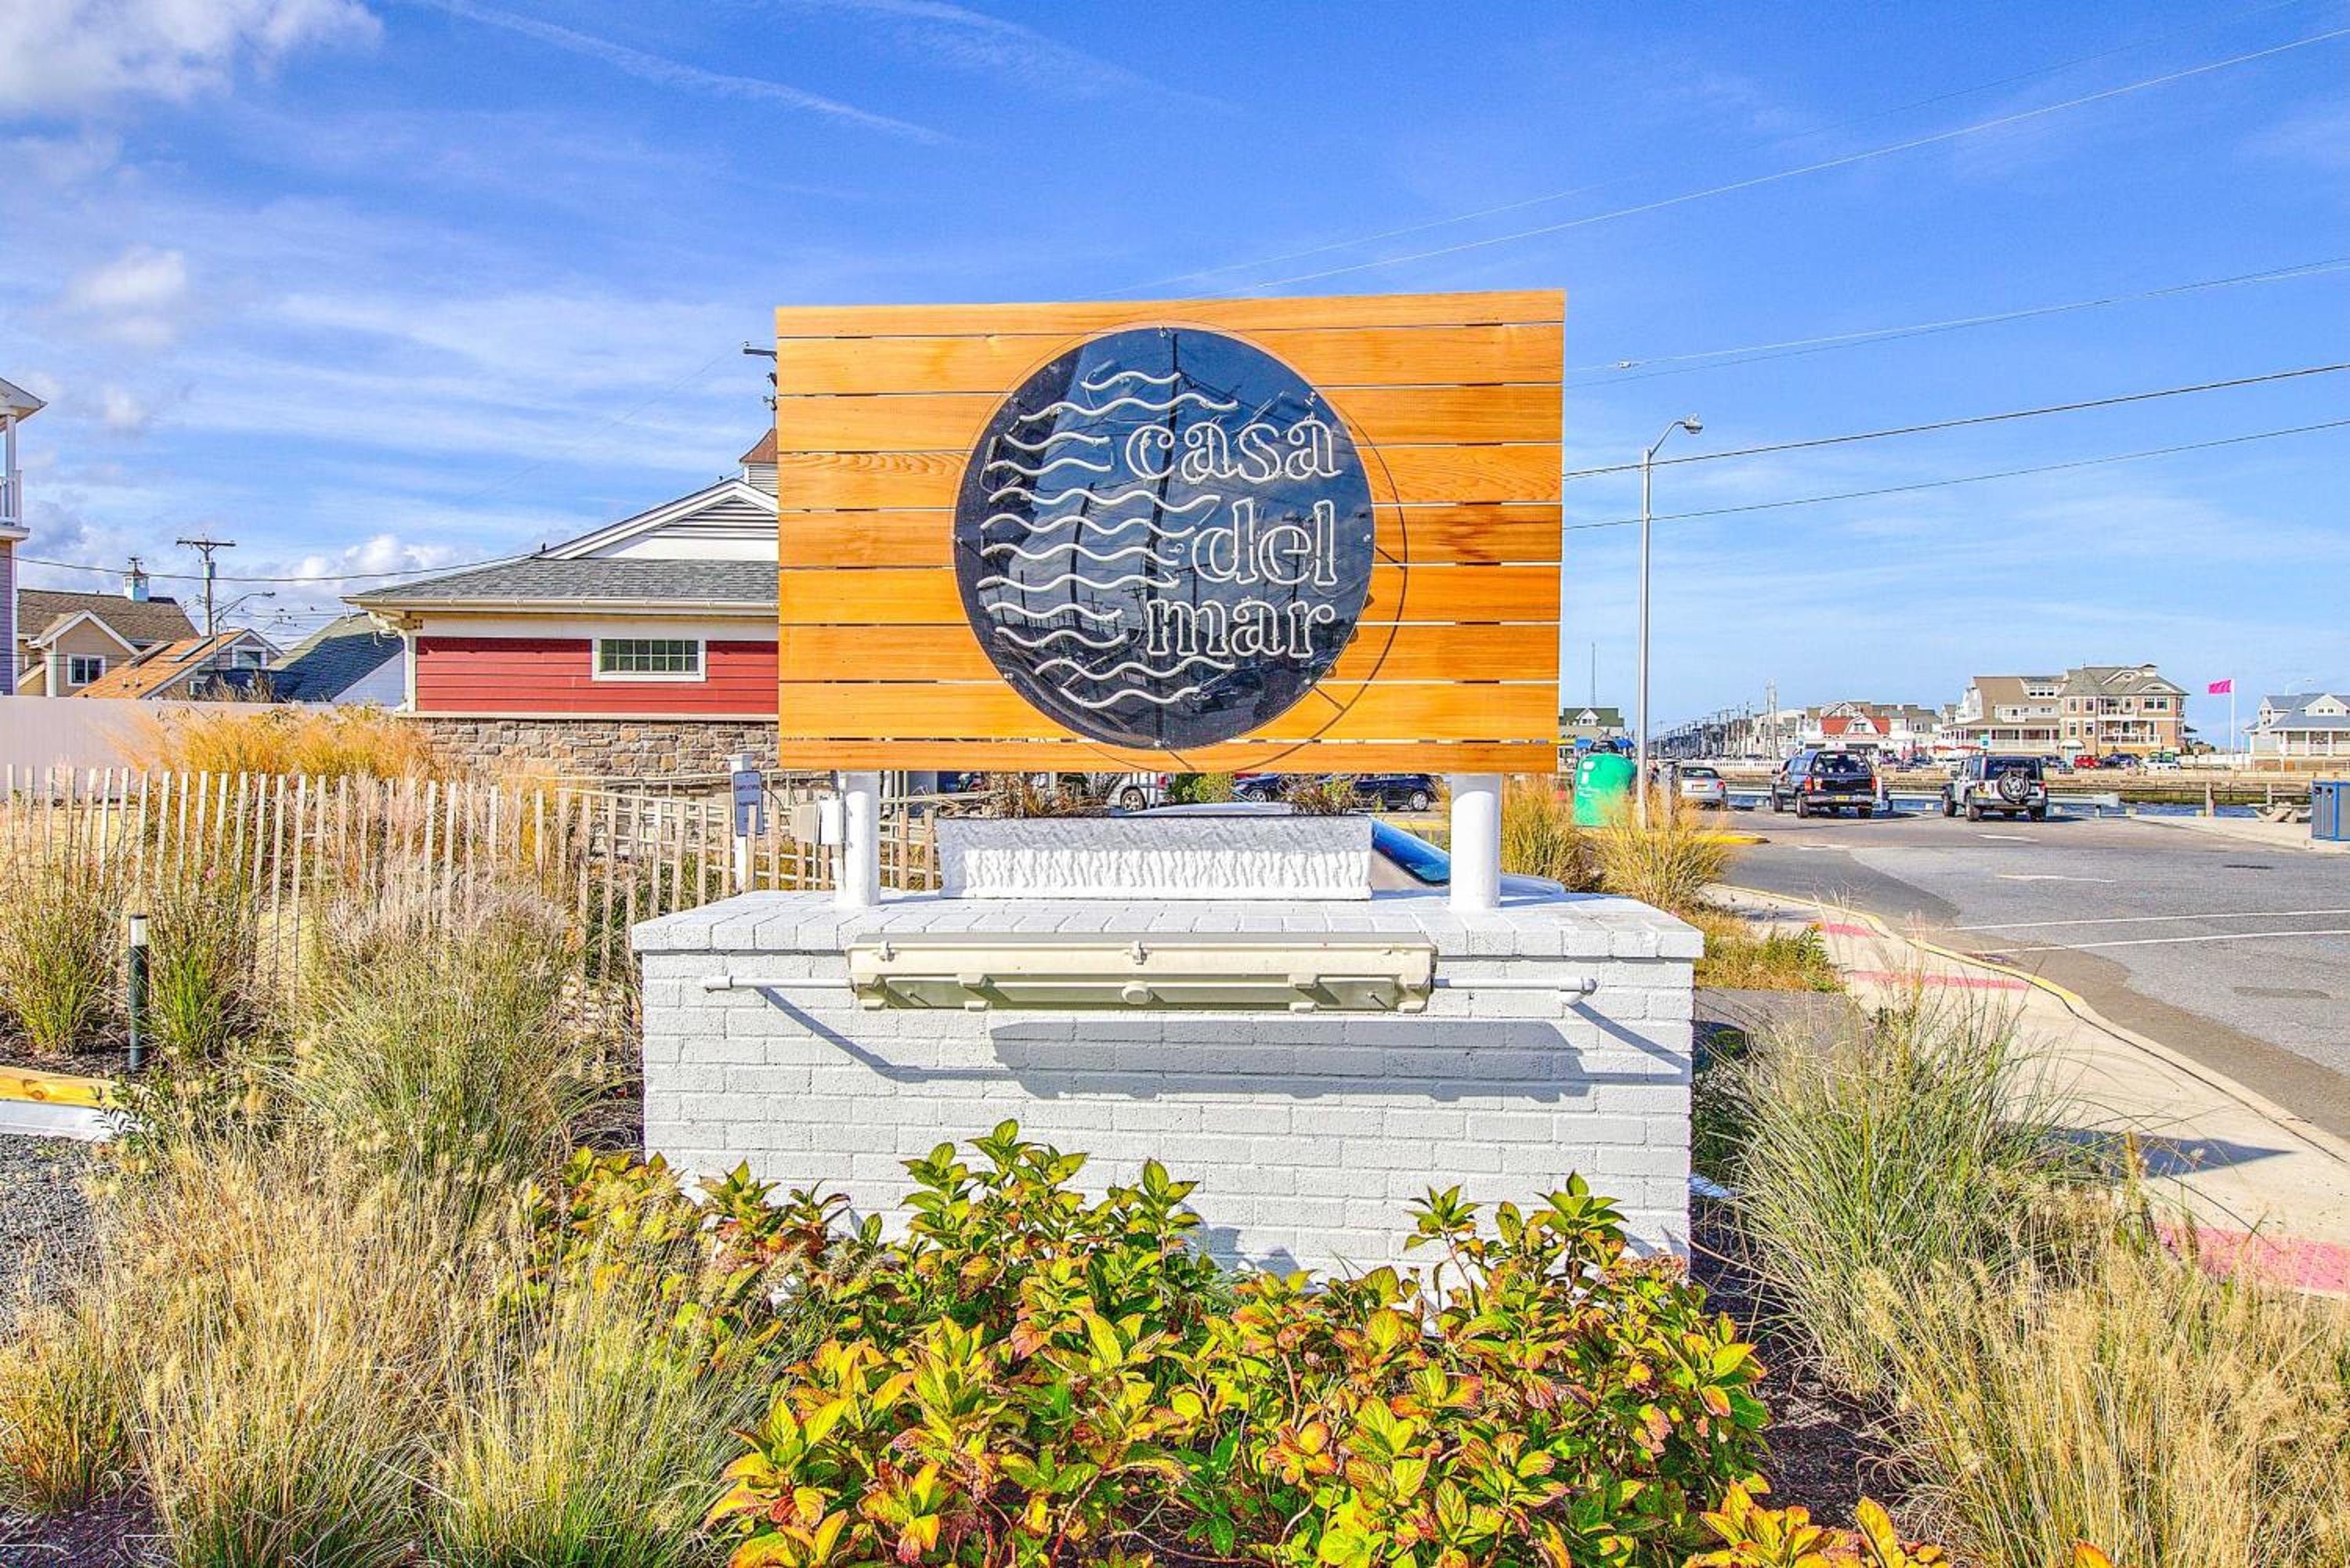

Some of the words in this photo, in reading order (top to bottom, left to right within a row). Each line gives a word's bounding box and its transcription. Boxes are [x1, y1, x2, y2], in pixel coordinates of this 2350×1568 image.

[1126, 421, 1343, 484] casa
[1191, 497, 1337, 585] del
[1146, 598, 1336, 658] mar
